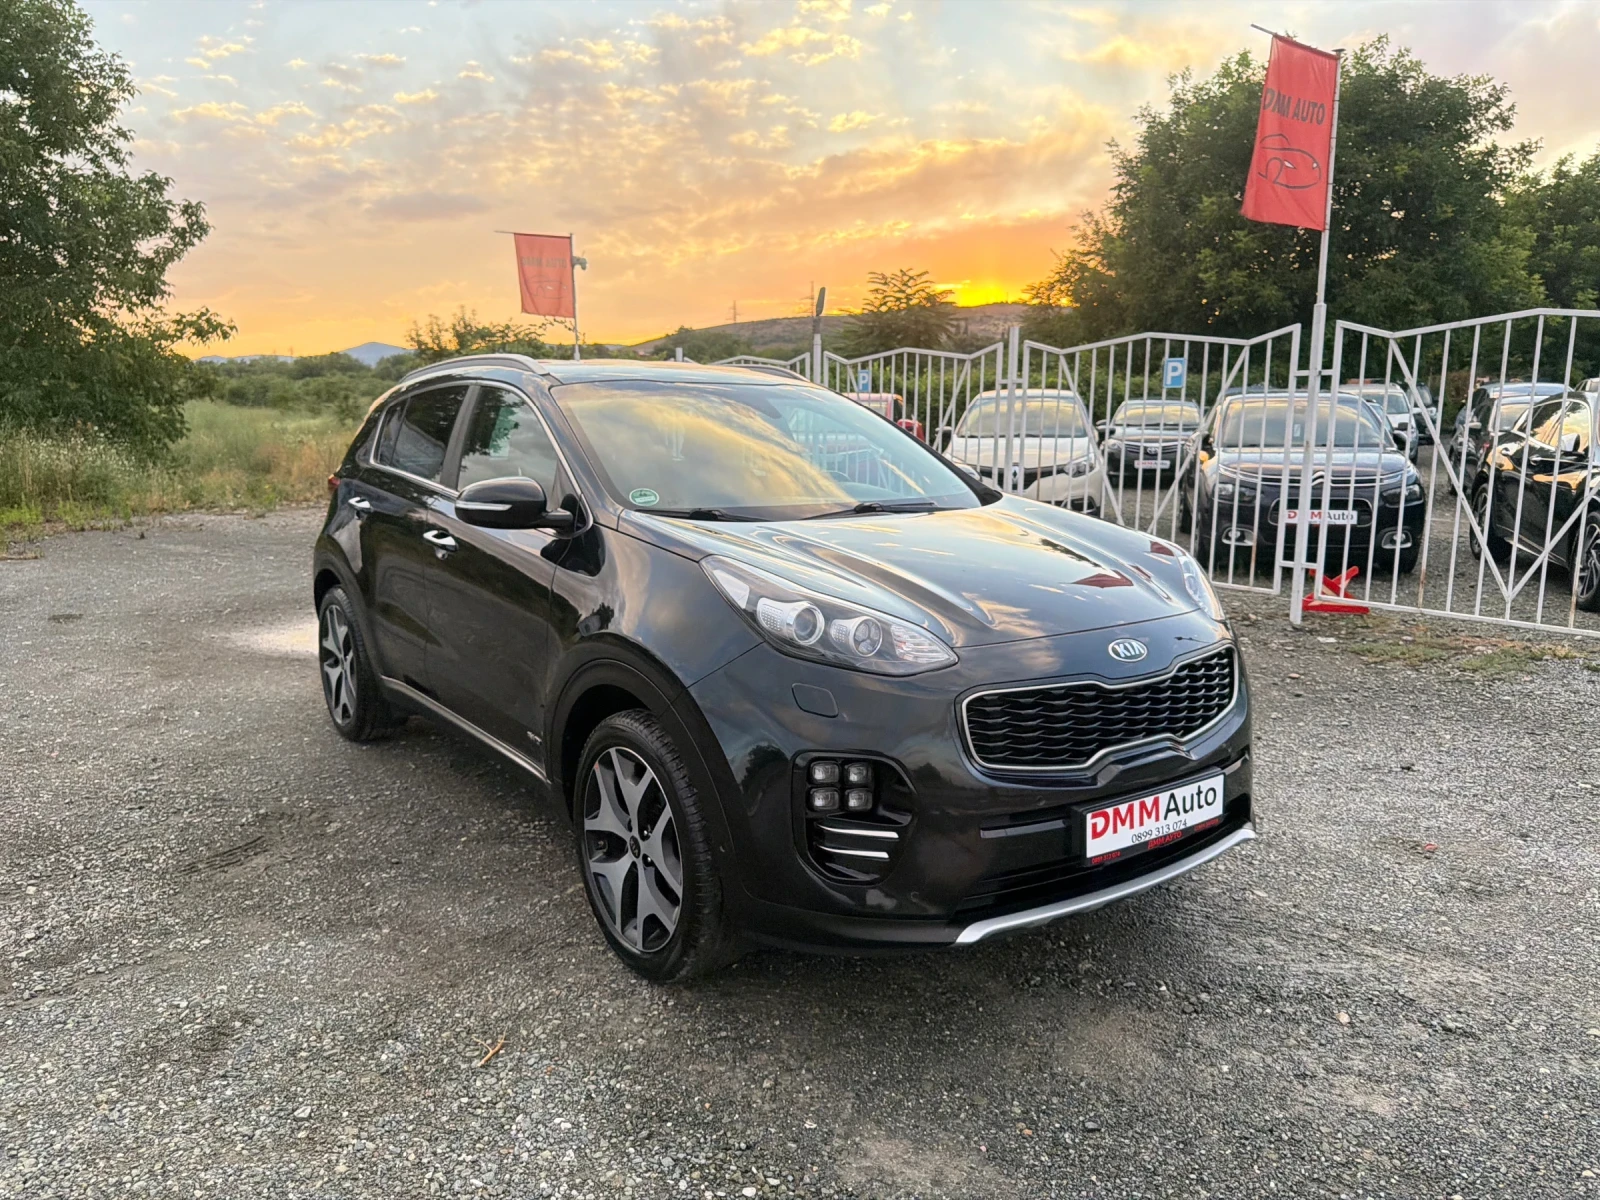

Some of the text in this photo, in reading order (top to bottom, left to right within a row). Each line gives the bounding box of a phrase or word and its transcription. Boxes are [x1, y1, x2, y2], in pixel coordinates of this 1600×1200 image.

[1292, 97, 1326, 126] AUTO
[1166, 361, 1183, 385] P
[1113, 641, 1145, 658] KIA
[1131, 829, 1153, 844] 0899
[1155, 824, 1171, 837] 313
[1172, 818, 1188, 831] 074
